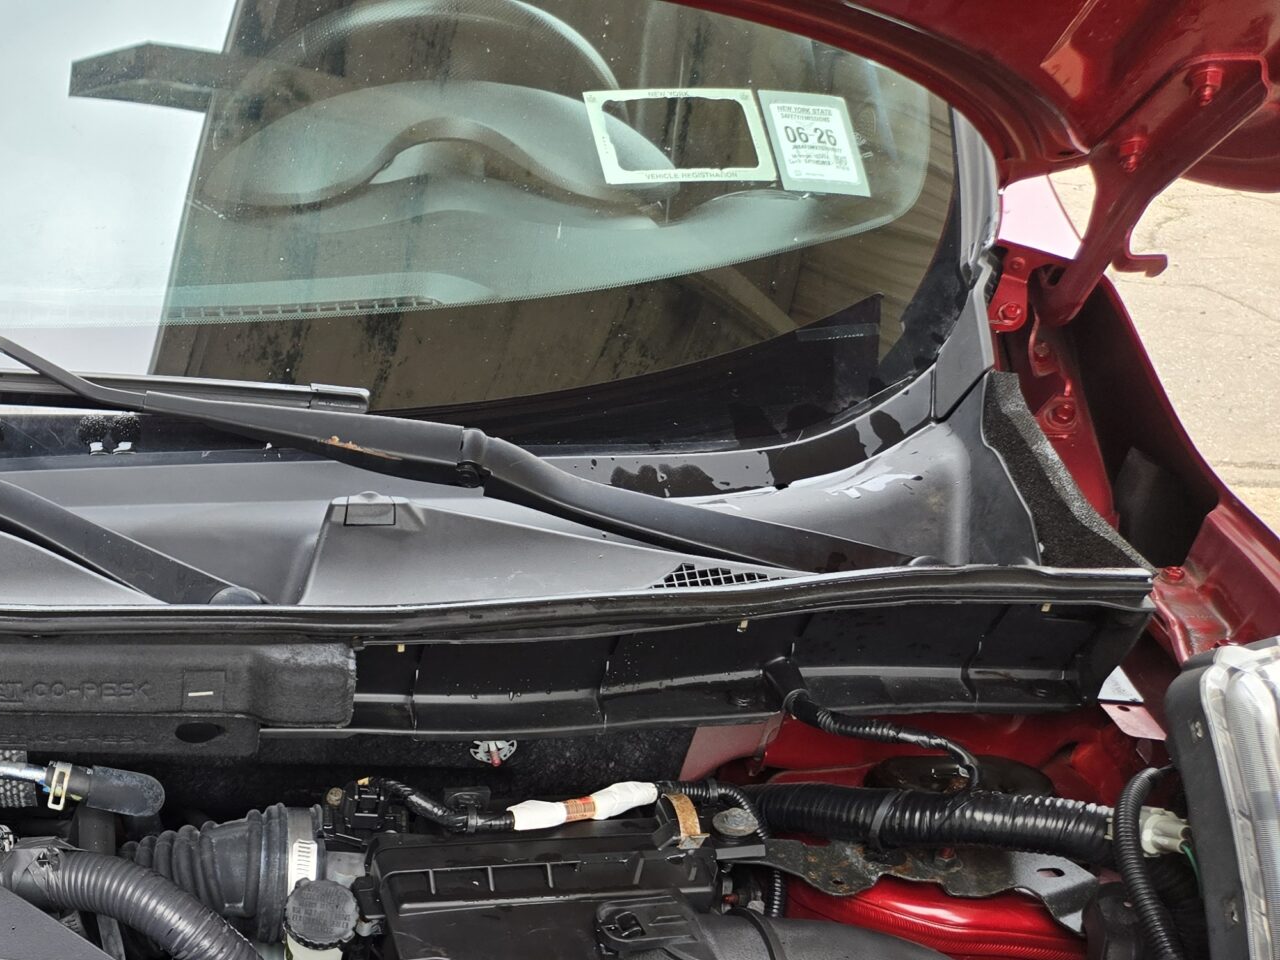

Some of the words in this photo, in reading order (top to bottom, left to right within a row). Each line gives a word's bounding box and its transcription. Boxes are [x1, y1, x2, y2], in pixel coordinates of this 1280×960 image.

[794, 106, 811, 115] YORK
[812, 108, 832, 116] STATE
[784, 125, 837, 146] 06-26
[646, 172, 680, 180] VEHICLE
[681, 171, 738, 179] REGISTRATION
